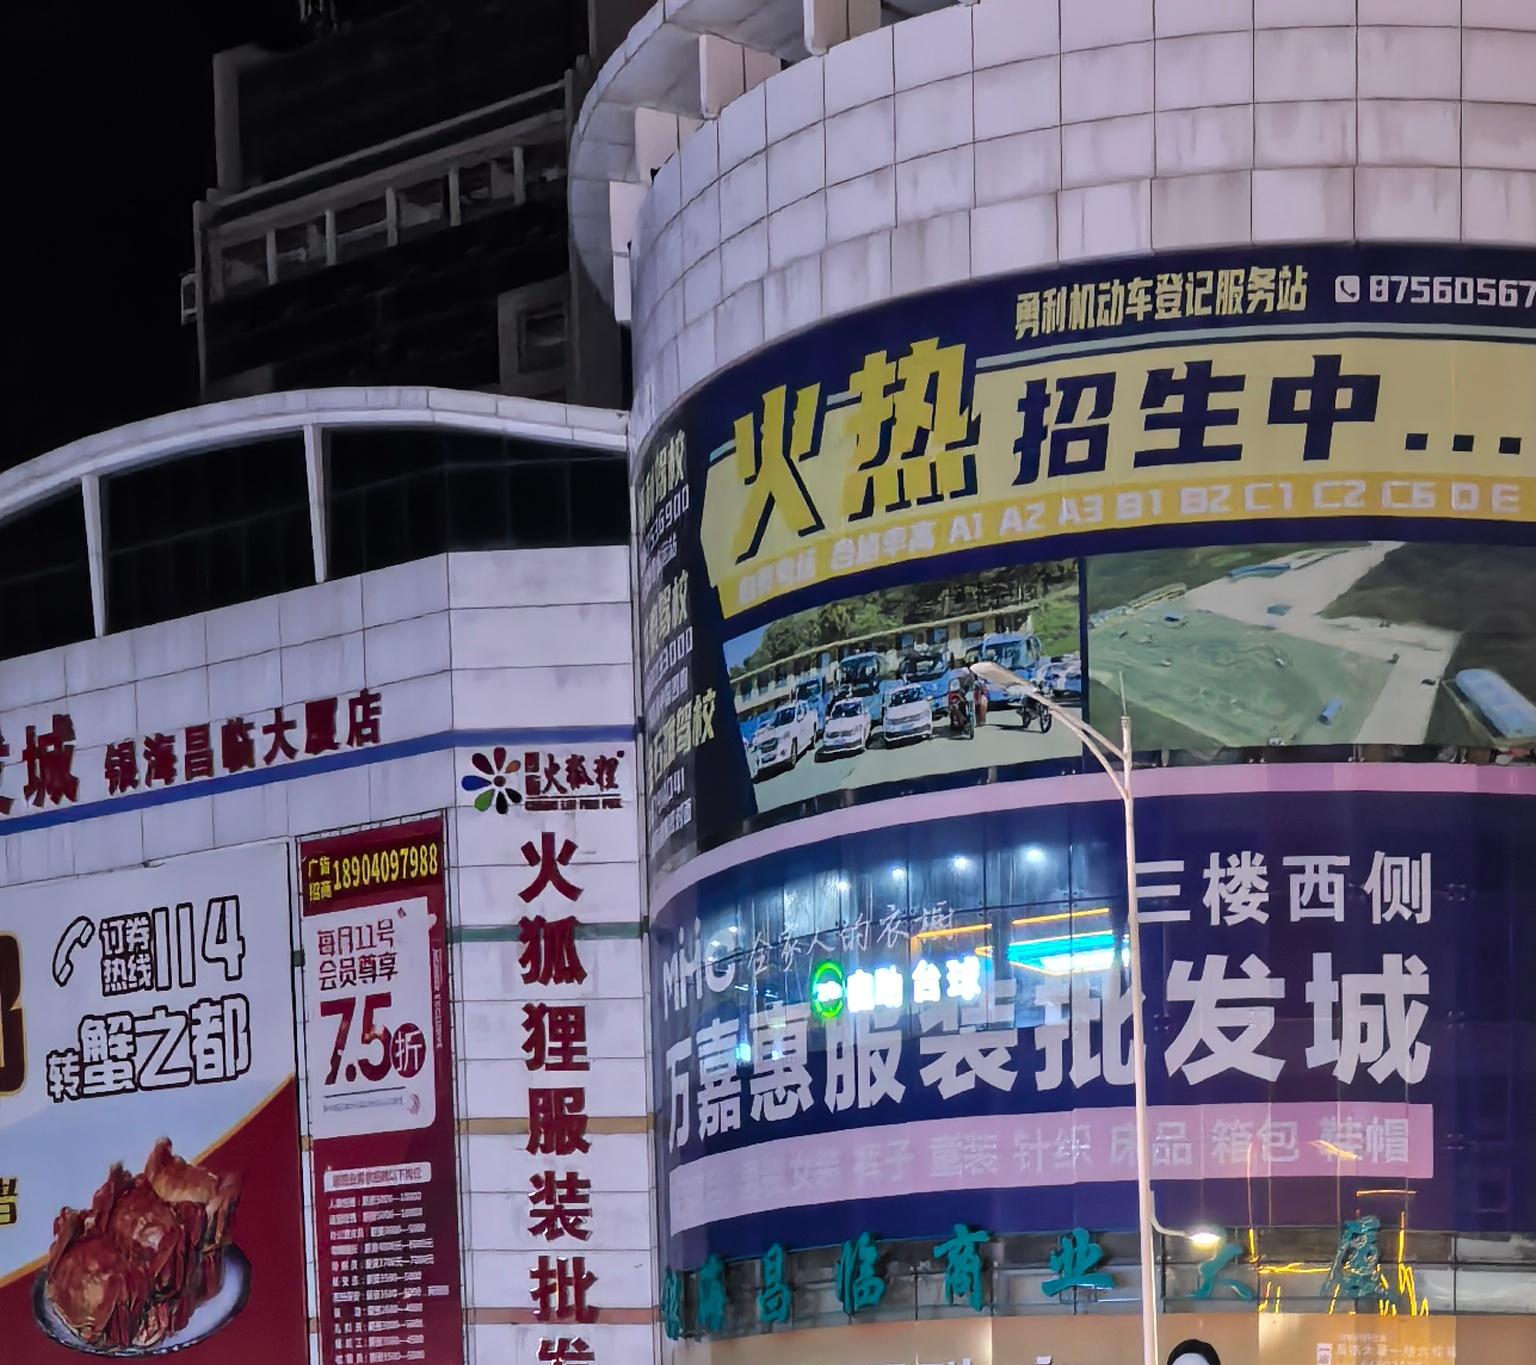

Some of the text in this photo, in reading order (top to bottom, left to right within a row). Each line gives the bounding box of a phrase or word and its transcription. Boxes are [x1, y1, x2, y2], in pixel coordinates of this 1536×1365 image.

[1015, 264, 1309, 341] 勇利机动车登记服务站
[733, 337, 980, 566] 火热
[950, 512, 983, 544] A1
[999, 503, 1046, 536] A2
[1058, 494, 1103, 527] A3
[1115, 489, 1162, 521] B1
[1180, 484, 1232, 515] B2
[1244, 480, 1292, 511] C1
[1312, 479, 1367, 509] C2
[1450, 483, 1480, 512] D
[1492, 484, 1521, 514] E
[333, 843, 439, 891] 18904097988
[1135, 850, 1433, 927] 三楼西侧
[101, 912, 152, 957] 订券
[152, 895, 246, 992] 114
[317, 917, 395, 957] 每月11号
[101, 952, 154, 996] 热线
[319, 950, 398, 992] 会员尊享
[46, 993, 252, 1103] 转蟹之都
[664, 951, 1433, 1154] 万嘉惠服装批发城
[1211, 1116, 1299, 1165] 箱包
